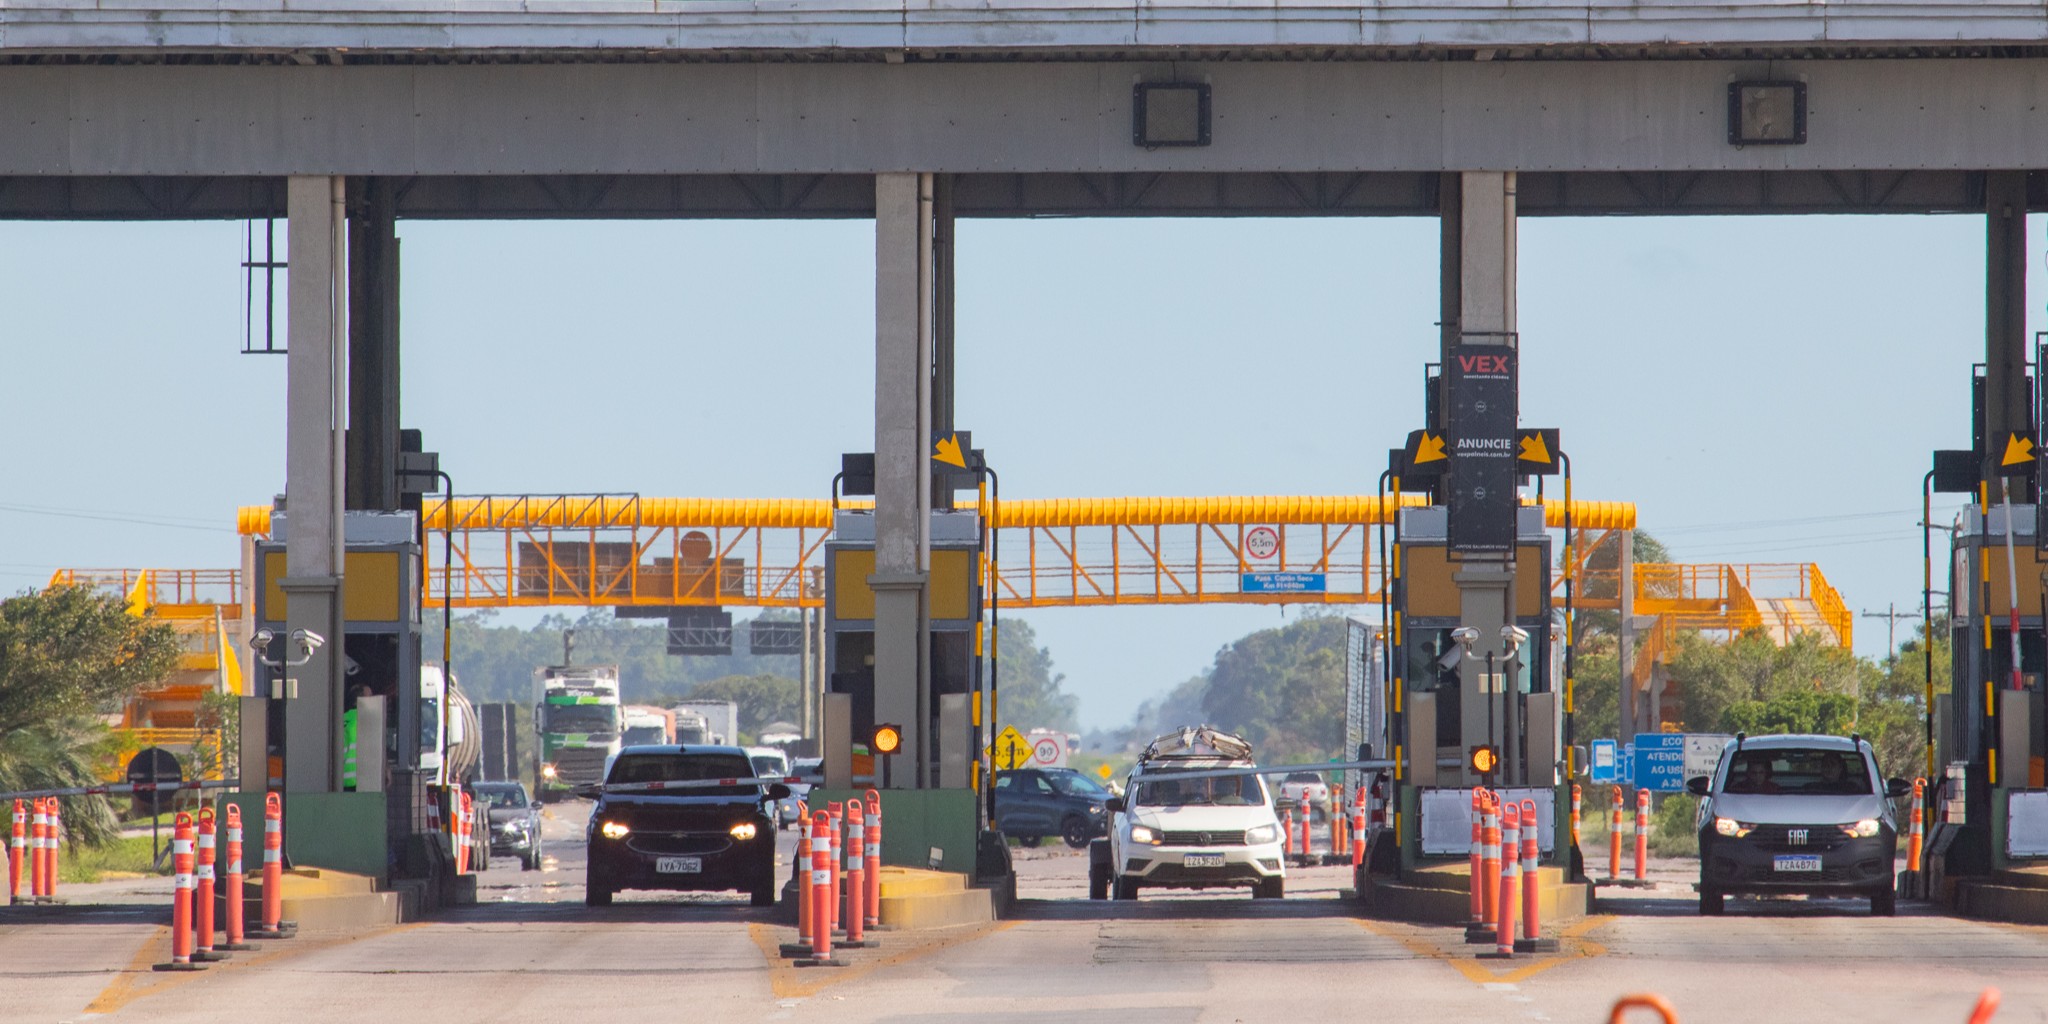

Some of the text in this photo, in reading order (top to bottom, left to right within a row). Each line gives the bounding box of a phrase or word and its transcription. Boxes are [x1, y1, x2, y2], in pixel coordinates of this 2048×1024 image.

[1458, 354, 1509, 373] VEX
[1457, 438, 1511, 449] ANUNCIE
[1040, 746, 1053, 757] 90
[1651, 765, 1665, 774] AO
[1788, 829, 1809, 846] FIAT
